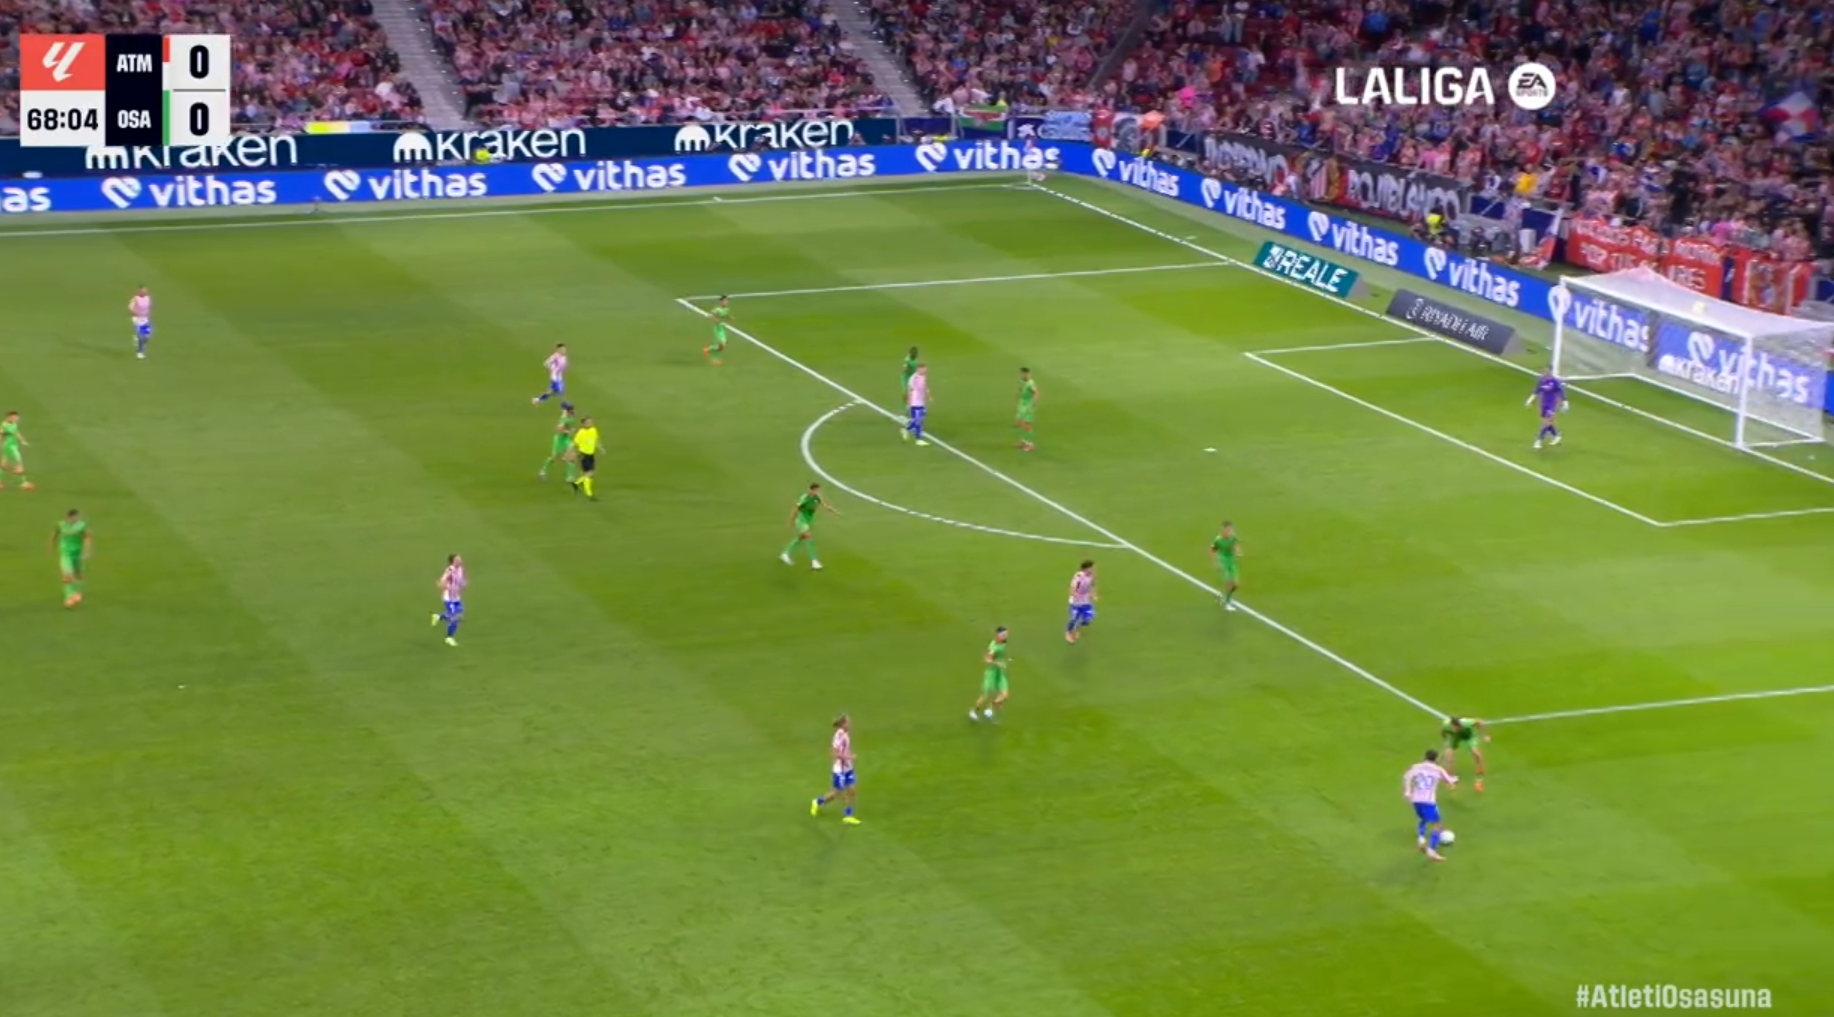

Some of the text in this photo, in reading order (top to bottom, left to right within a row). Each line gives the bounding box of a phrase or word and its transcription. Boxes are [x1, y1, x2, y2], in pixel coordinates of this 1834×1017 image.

[436, 128, 587, 161] kraken
[714, 119, 854, 149] kraken
[768, 149, 876, 181] vithas
[953, 140, 1060, 170] vithas
[148, 175, 277, 206] vithas
[368, 168, 488, 200] vithas
[573, 159, 687, 191] vithas
[1118, 156, 1180, 197] vithas
[1224, 187, 1286, 230] vithas
[1331, 220, 1398, 266] vithas
[1276, 250, 1348, 292] REALE
[1450, 258, 1520, 308] vithas
